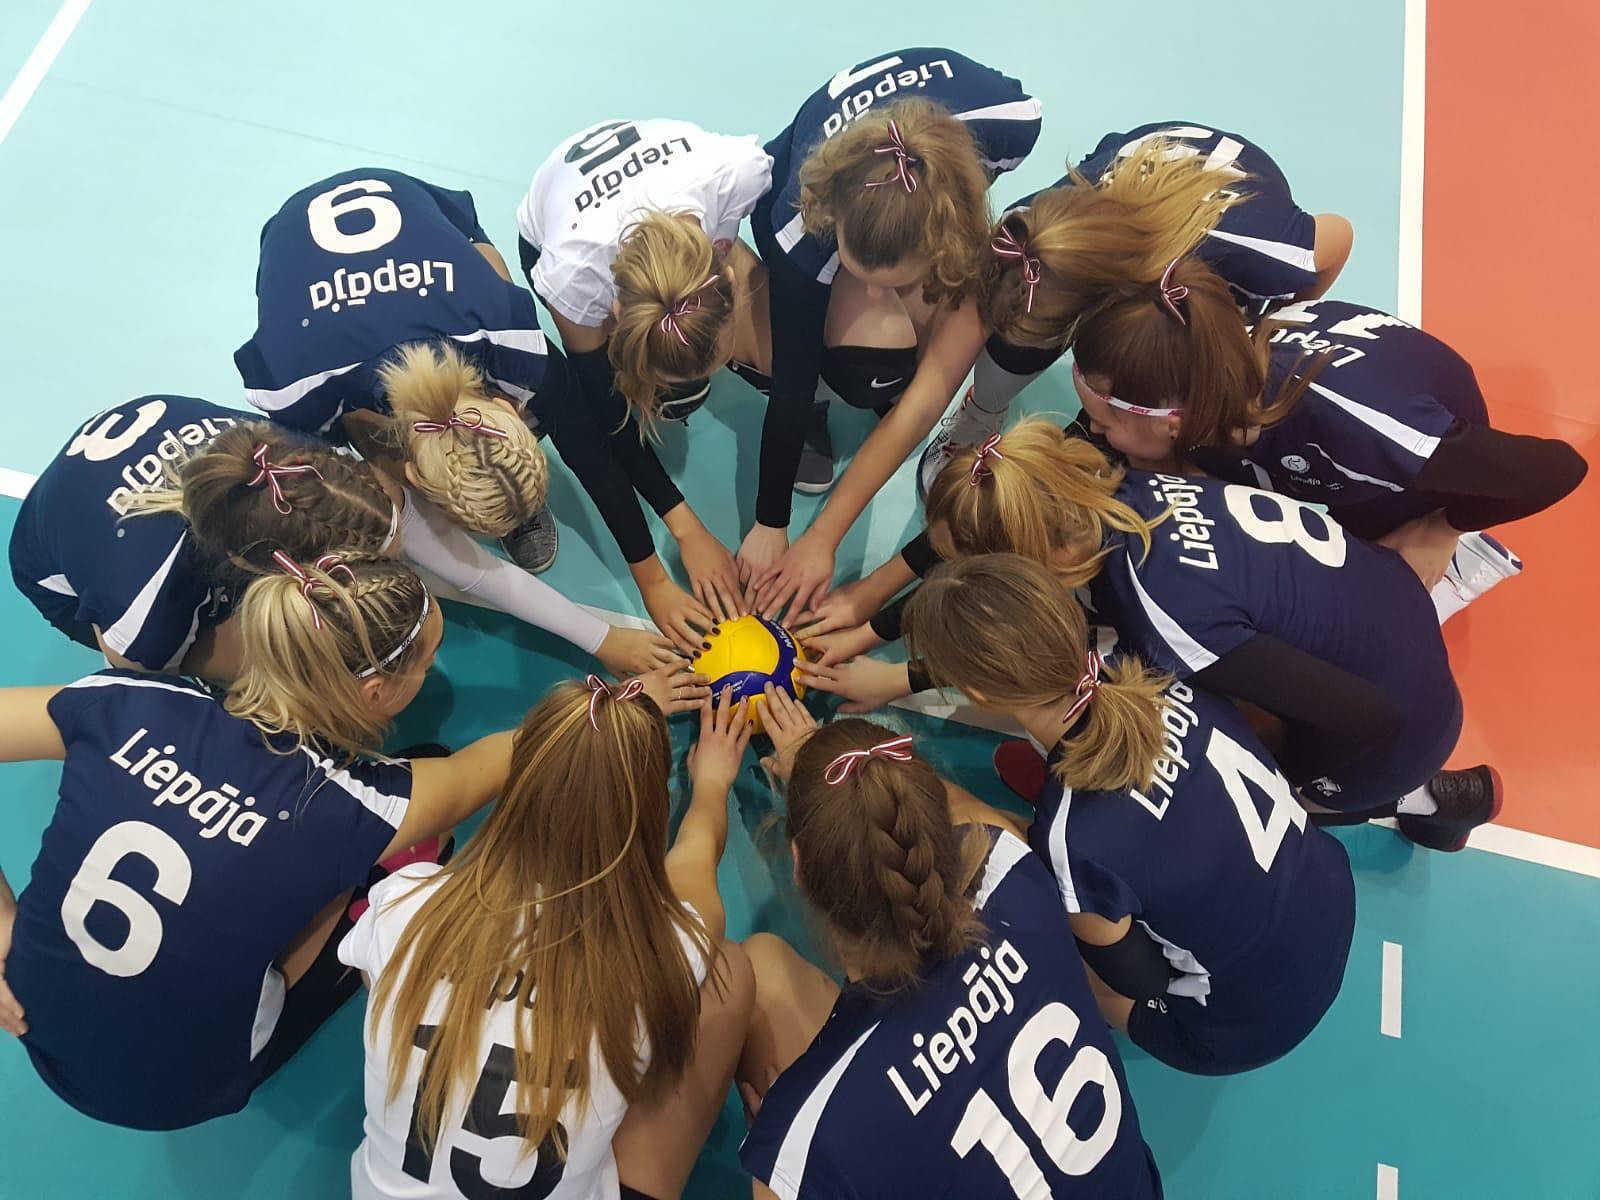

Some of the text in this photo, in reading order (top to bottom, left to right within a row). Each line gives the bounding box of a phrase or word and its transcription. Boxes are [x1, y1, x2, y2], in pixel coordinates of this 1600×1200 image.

[823, 60, 954, 139] Liepāja
[564, 121, 642, 176] 5
[574, 137, 692, 212] Liepāja
[307, 179, 402, 254] 9
[309, 258, 454, 313] Liepāja
[66, 399, 167, 461] 3
[1148, 473, 1219, 570] Liepāja
[1223, 484, 1347, 568] 8
[109, 727, 268, 847] Liepāja
[1205, 727, 1308, 873] 4
[61, 820, 193, 978] 6
[886, 939, 1029, 1117] Liepāja
[401, 1024, 582, 1200] 15
[950, 1002, 1122, 1200] 16
